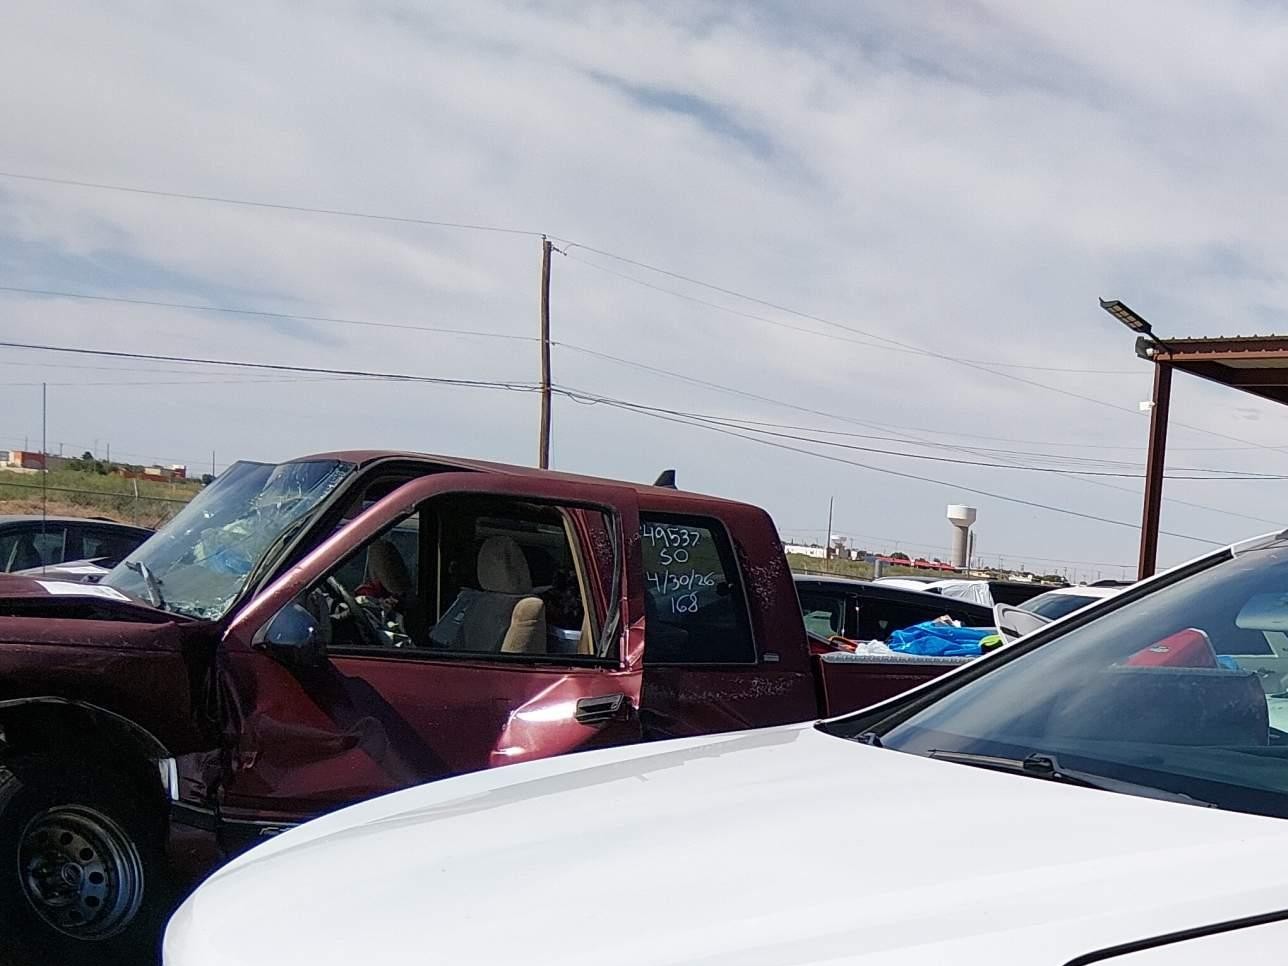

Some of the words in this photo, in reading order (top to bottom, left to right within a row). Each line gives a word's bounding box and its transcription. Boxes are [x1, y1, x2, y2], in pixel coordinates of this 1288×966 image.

[642, 524, 700, 547] 49537
[647, 569, 715, 594] 4/30/26
[671, 591, 699, 613] 168
